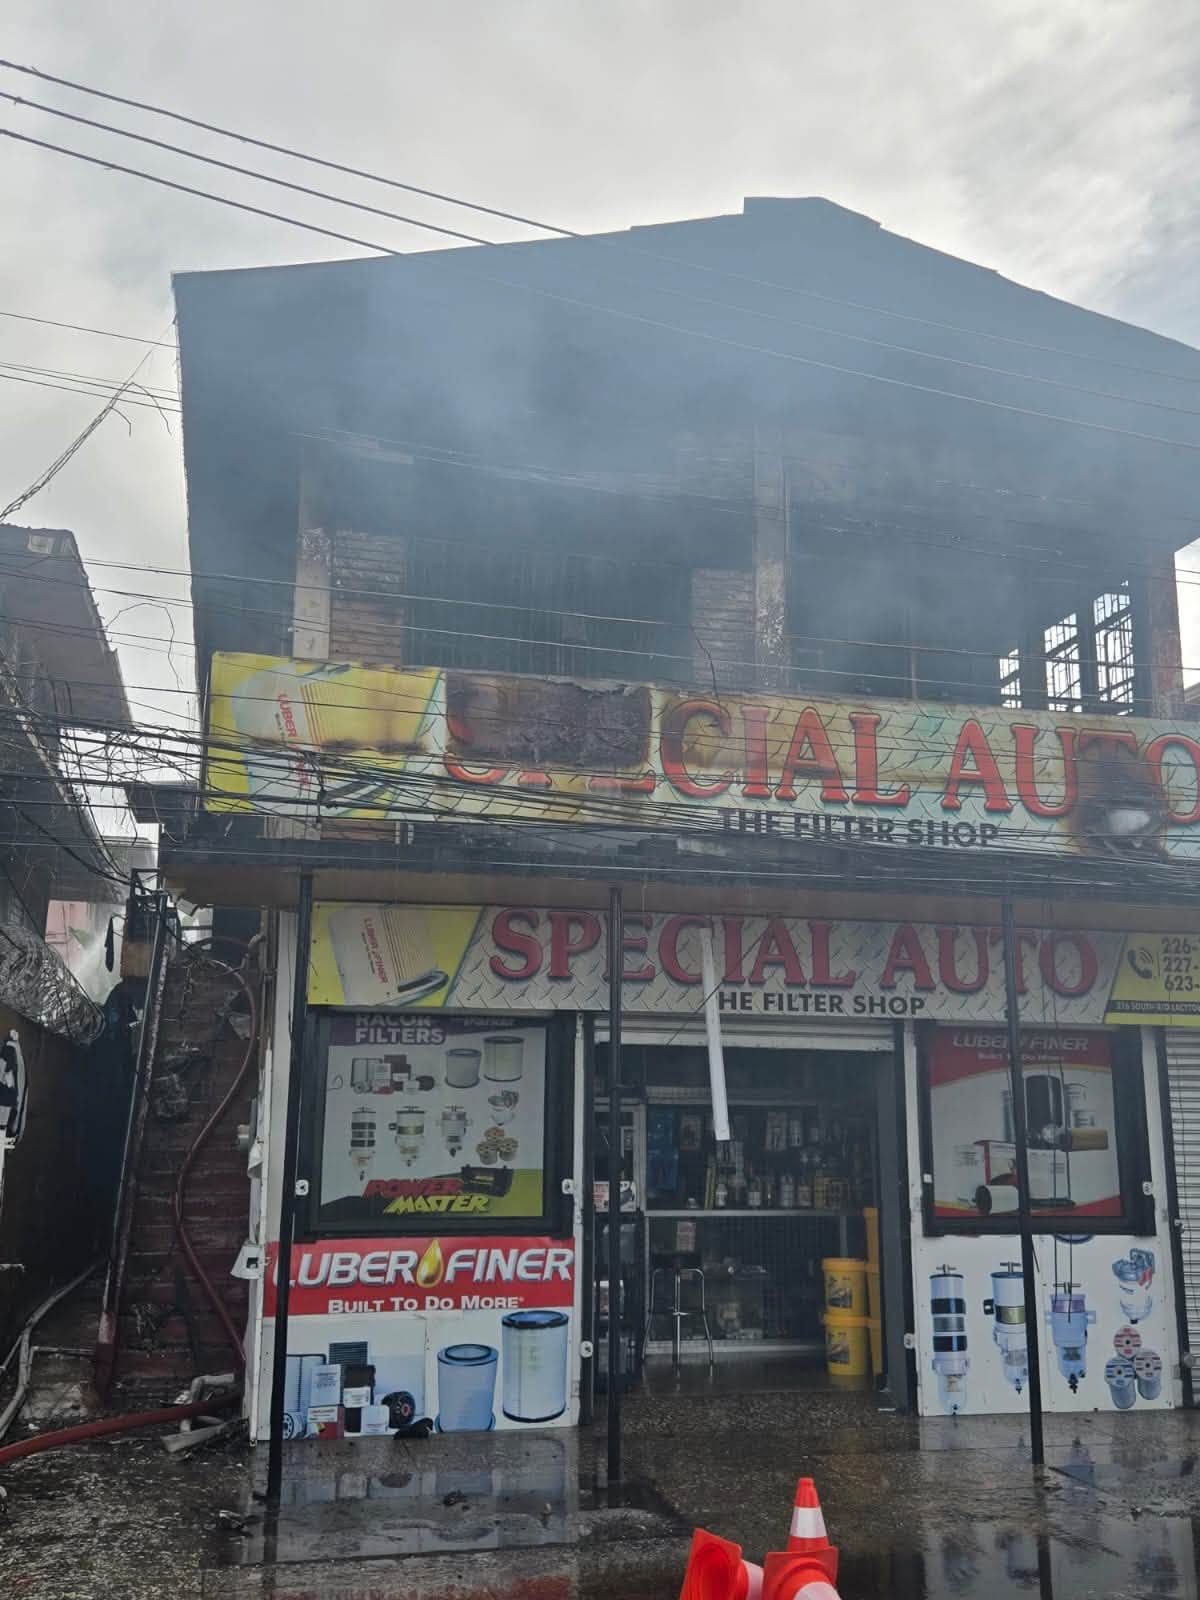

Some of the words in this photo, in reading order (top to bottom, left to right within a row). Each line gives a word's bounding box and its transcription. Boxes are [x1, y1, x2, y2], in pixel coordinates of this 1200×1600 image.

[795, 814, 896, 843] FILTER
[908, 819, 999, 848] SHOP
[879, 920, 1100, 997] AUTO
[717, 991, 754, 1012] HE
[762, 992, 849, 1014] FILTER
[853, 994, 926, 1016] SHOP
[355, 1028, 444, 1044] FILTERS
[1028, 1034, 1089, 1051] FINER
[363, 1177, 464, 1198] POWER
[383, 1194, 490, 1214] MASTER
[444, 1248, 575, 1284] FINER
[328, 1299, 385, 1314] BUILT
